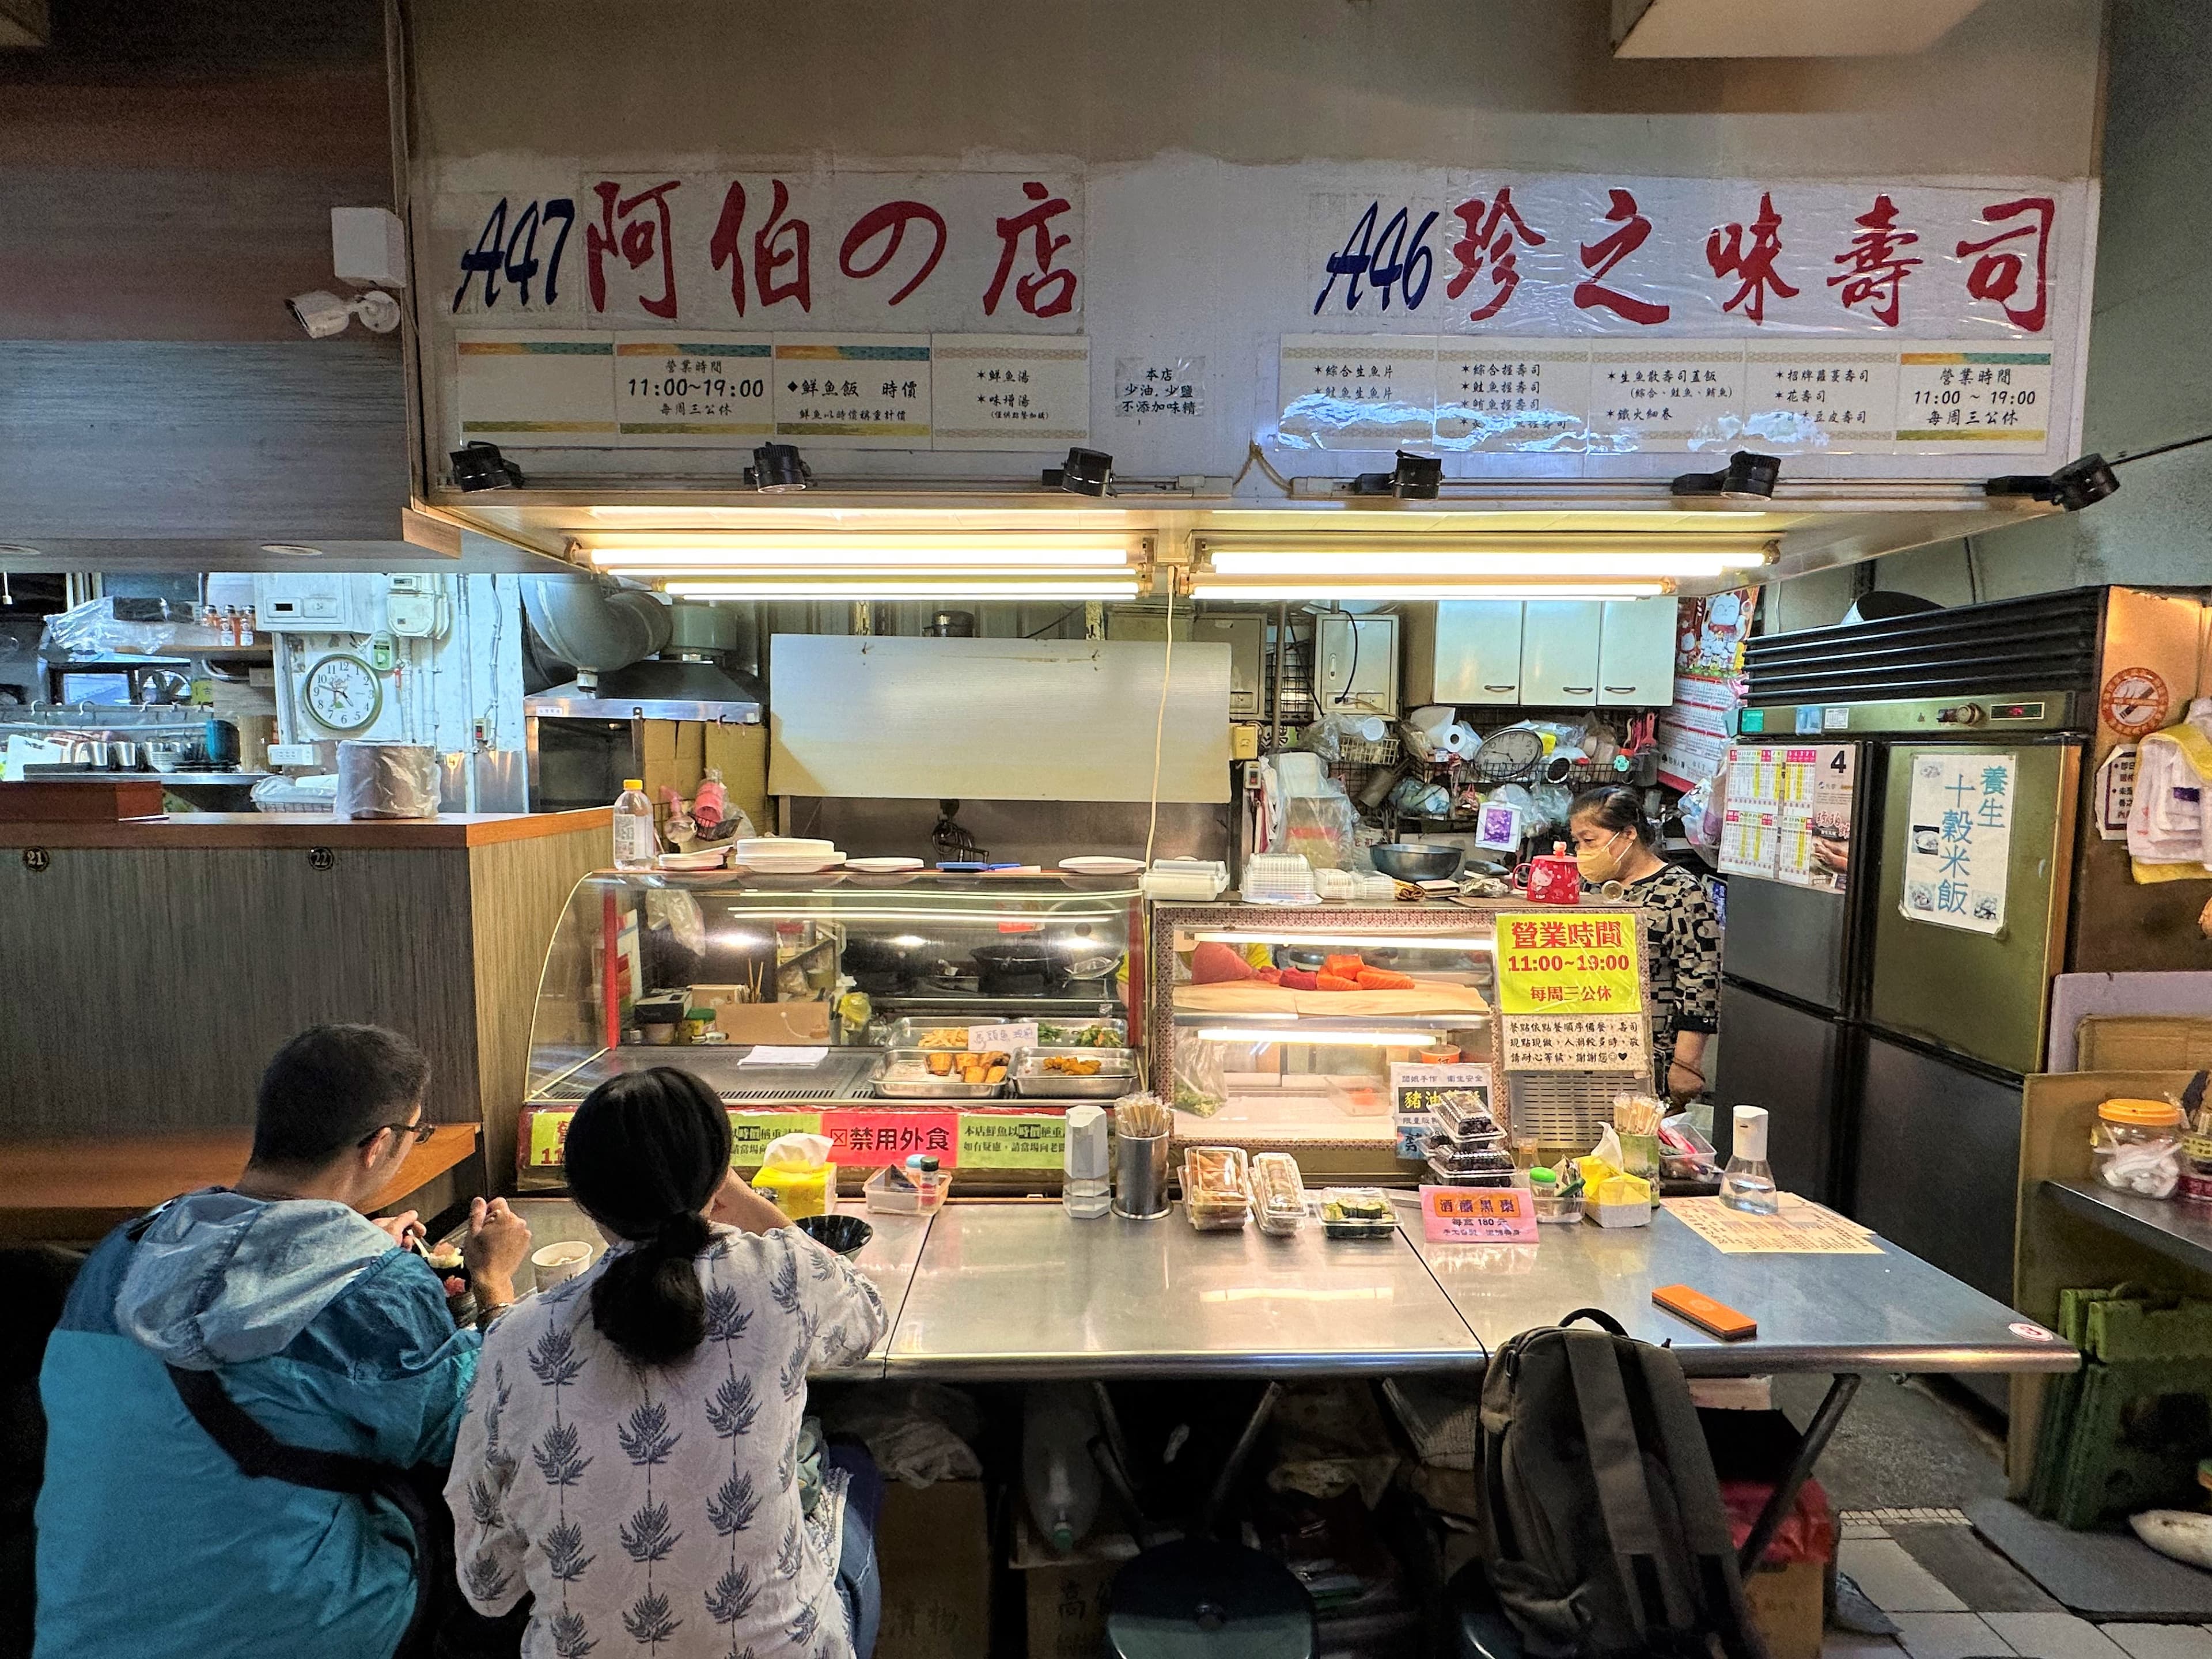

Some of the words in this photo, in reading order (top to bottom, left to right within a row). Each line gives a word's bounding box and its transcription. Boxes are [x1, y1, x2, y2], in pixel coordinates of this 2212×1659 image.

[453, 197, 574, 313] A47
[586, 179, 1078, 319] 阿伯の店
[1315, 201, 1440, 316] A46
[1446, 186, 2056, 333] 珍之味壽司
[666, 360, 722, 374] 營業時間
[1146, 367, 1172, 381] 本店
[1325, 364, 1393, 378] 綜合生魚片
[1472, 363, 1541, 377] 綜合握壽司
[987, 370, 1030, 384] 鮮魚湯
[1940, 368, 2012, 387] 營業時間
[628, 378, 764, 398] 11:00~19:00
[800, 380, 859, 398] 鮮魚飯
[881, 381, 918, 399] 時價
[1787, 389, 1826, 403] 花壽司
[1914, 391, 1961, 405] 11:00
[1990, 391, 2036, 405] 19:00
[1122, 400, 1196, 415] 不添加味精
[1926, 410, 2019, 427] 每周三公休
[328, 665, 335, 674] 11
[339, 661, 349, 671] 12
[355, 666, 359, 675] 1
[317, 674, 327, 684] 10
[363, 676, 369, 685] 2
[313, 687, 320, 696] 9
[368, 690, 374, 699] 3
[317, 700, 324, 709] 8
[365, 702, 369, 711] 4
[328, 710, 334, 719] 7
[340, 715, 347, 724] 6
[354, 711, 361, 721] 5
[1830, 750, 1847, 774] 4
[1976, 765, 2009, 828] 養生
[1937, 774, 1976, 916] 十穀米飯
[26, 850, 44, 865] 21
[313, 851, 328, 866] 22
[1511, 921, 1622, 948] 營業時間
[1530, 986, 1612, 1002] 每周三公休
[850, 1127, 950, 1151] 禁用外食
[1478, 1218, 1494, 1226] 180
